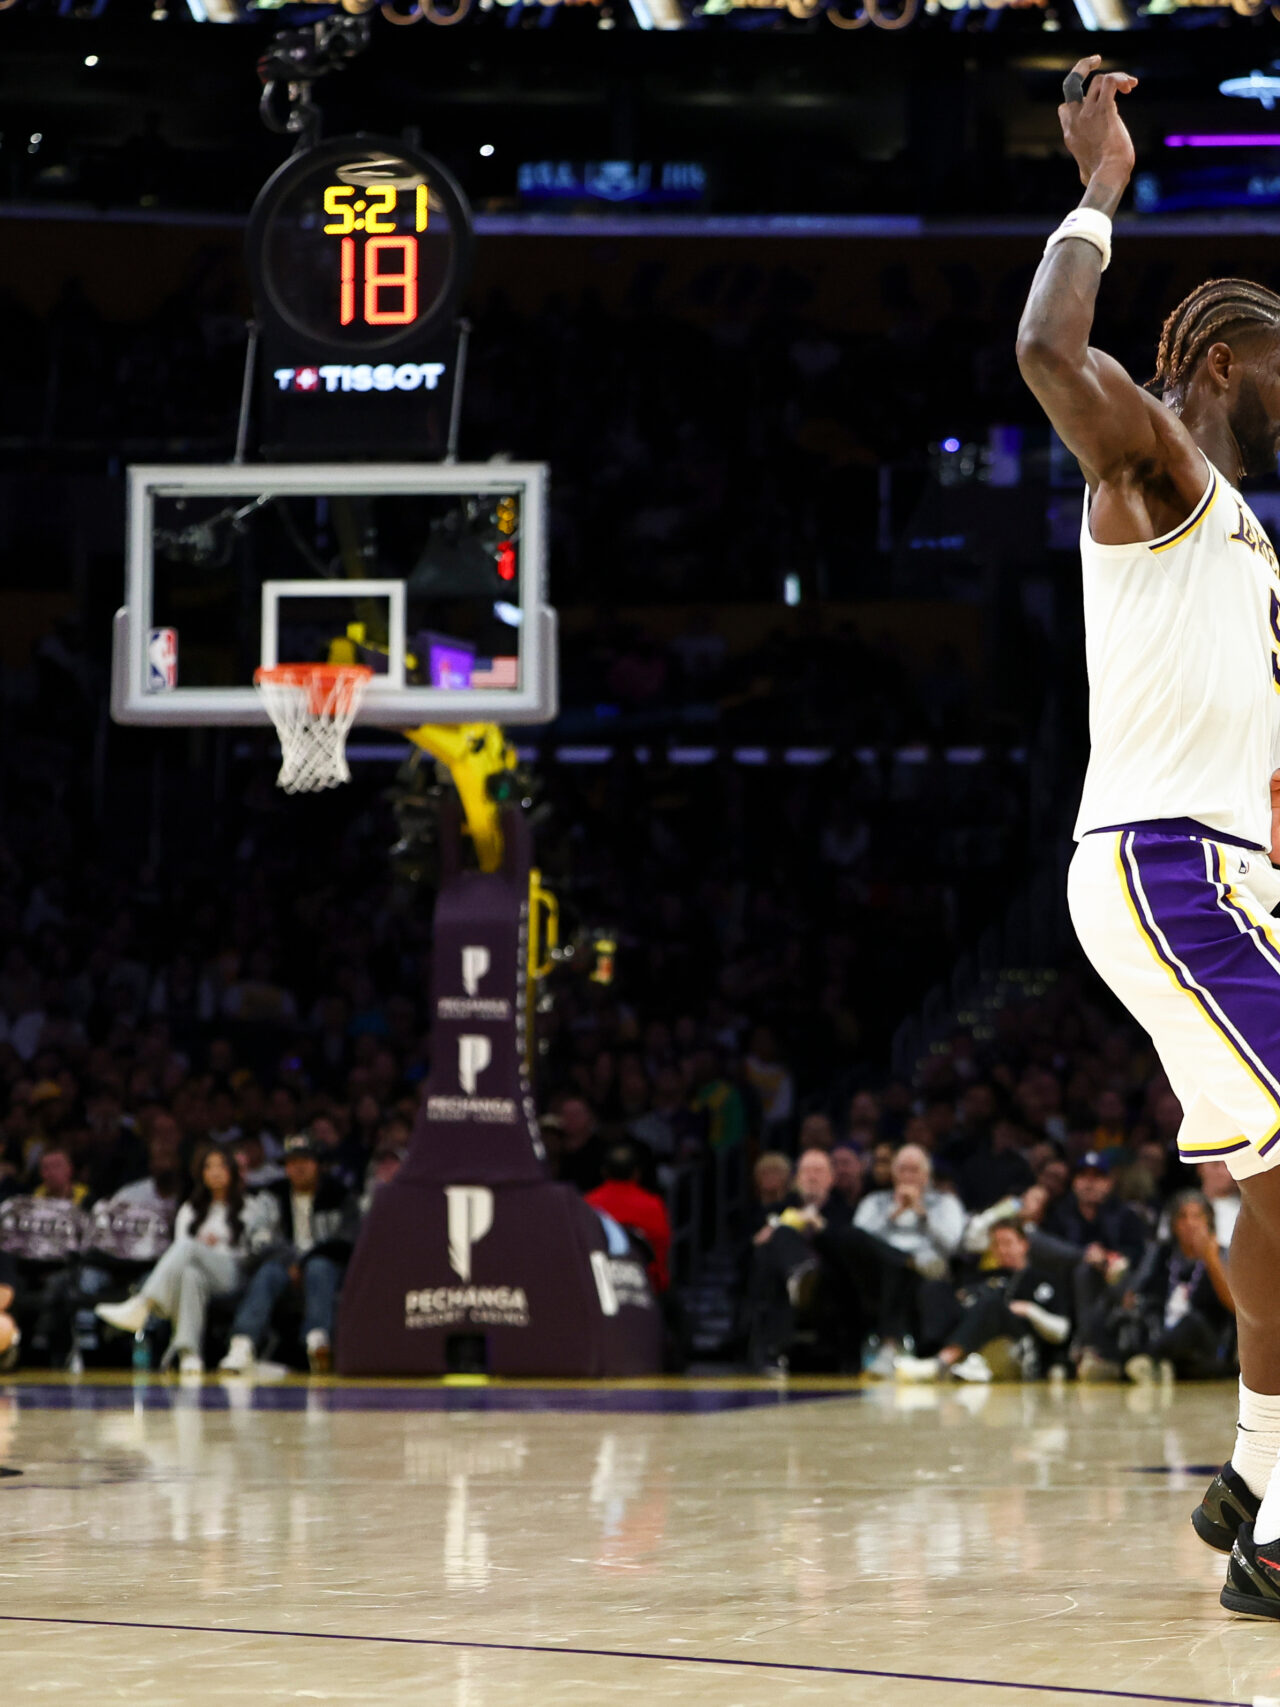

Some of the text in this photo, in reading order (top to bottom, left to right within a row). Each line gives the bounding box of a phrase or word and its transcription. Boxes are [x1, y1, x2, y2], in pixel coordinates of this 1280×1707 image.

[323, 184, 428, 234] 5:21
[340, 236, 418, 326] 18
[319, 363, 445, 392] TISSOT
